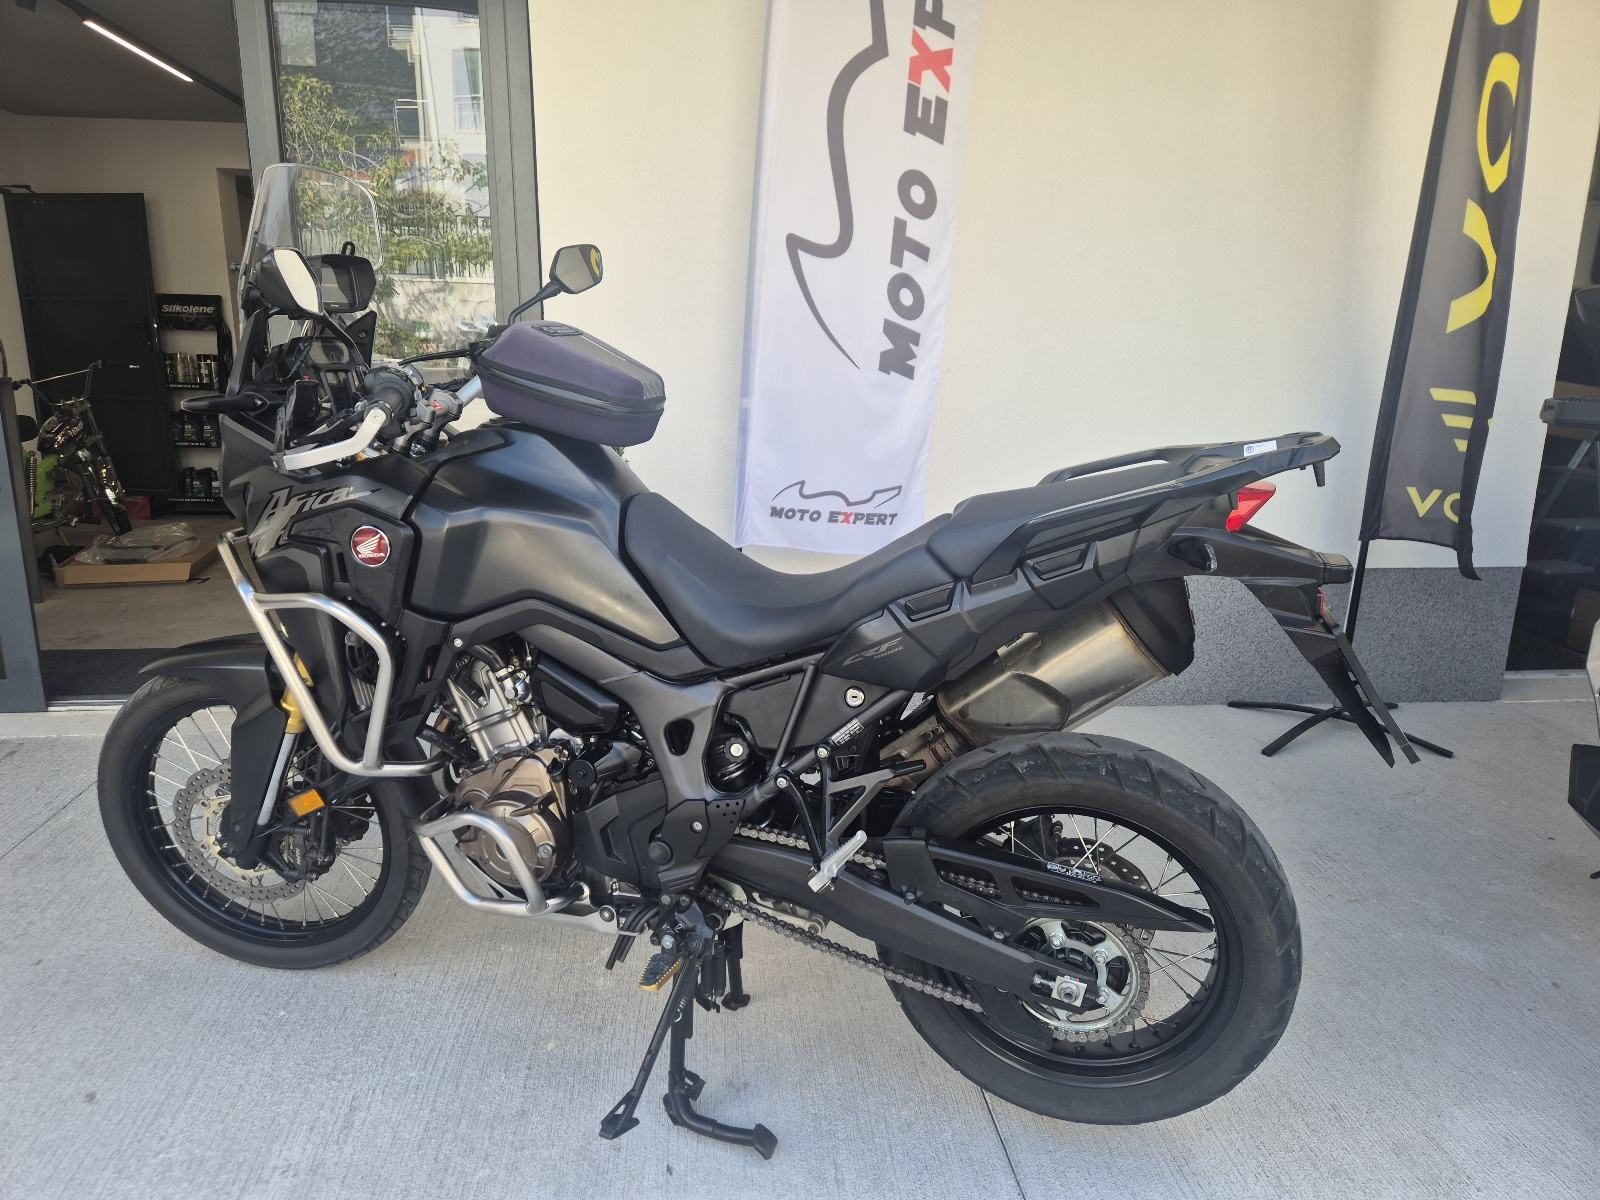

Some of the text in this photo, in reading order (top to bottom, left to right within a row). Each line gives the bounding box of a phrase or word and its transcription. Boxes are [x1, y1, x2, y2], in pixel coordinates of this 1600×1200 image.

[878, 169, 938, 380] MOTO
[161, 304, 216, 313] Silkolene
[769, 506, 898, 526] MOTO EXPERT
